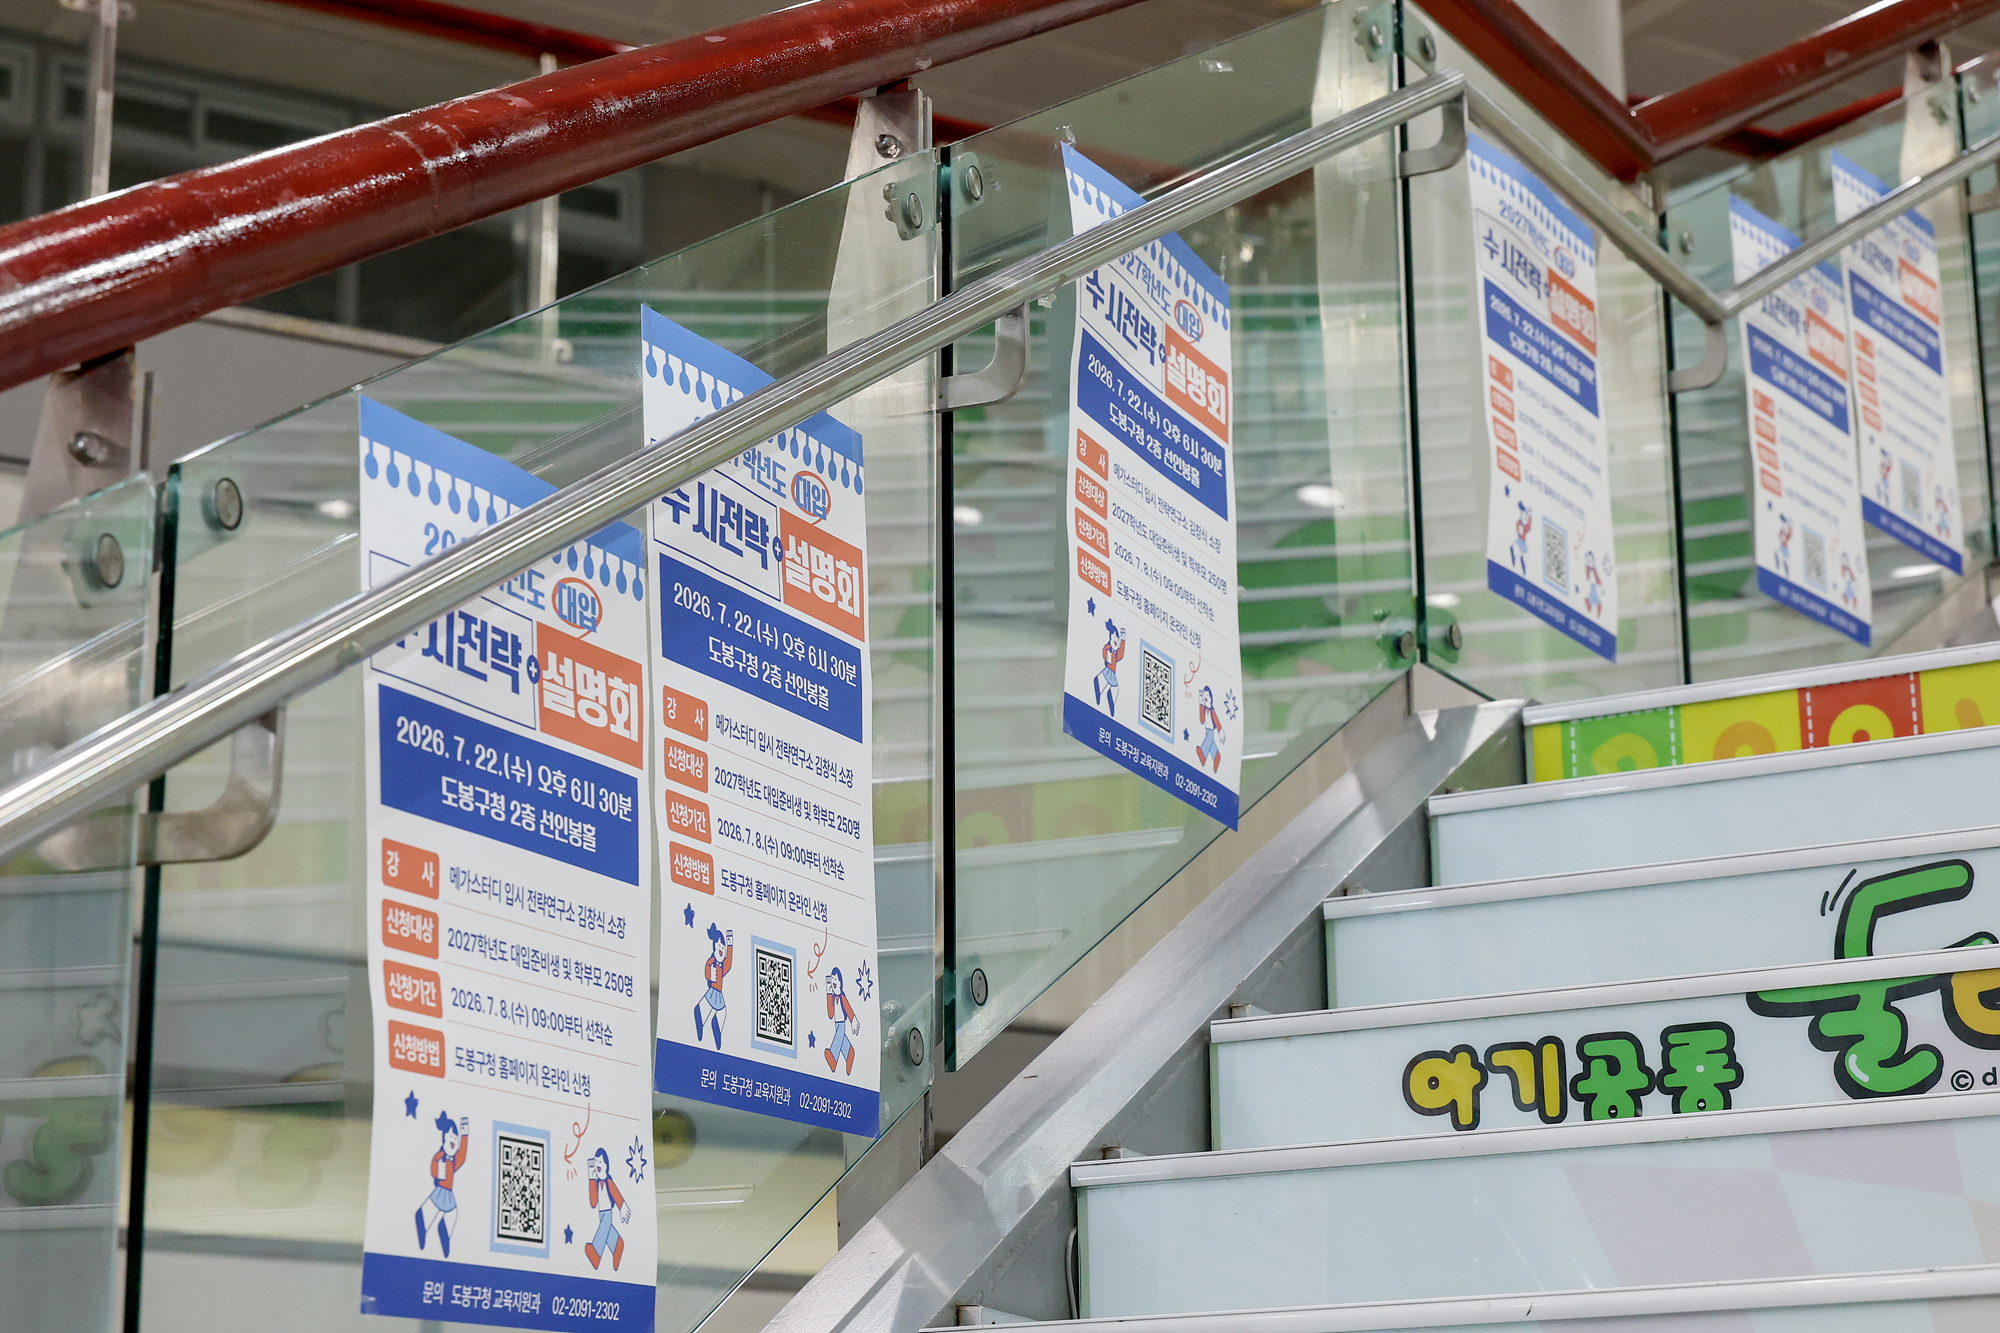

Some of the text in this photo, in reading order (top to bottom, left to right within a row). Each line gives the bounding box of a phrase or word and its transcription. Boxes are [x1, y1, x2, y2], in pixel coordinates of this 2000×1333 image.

[1484, 228, 1542, 300] 수시전략
[1086, 270, 1226, 426] 수시전략 설명회
[1178, 301, 1200, 342] 대입
[1088, 354, 1114, 392] 2026.
[1118, 378, 1126, 401] 7.
[1128, 389, 1160, 430] 22.(수)
[1163, 418, 1181, 444] 오후
[1201, 446, 1222, 478] 30분
[1110, 402, 1200, 489] 도봉구청 2층 선인봉홀
[796, 474, 826, 520] 대입
[1078, 474, 1105, 508] 신청대상
[1114, 462, 1144, 500] 메가스터디
[1209, 534, 1222, 554] 소장
[662, 481, 860, 618] 수시전략 설명회
[1078, 517, 1106, 550] 신청기간
[1112, 502, 1148, 540] 2027학년도
[1208, 570, 1228, 595] 250명
[1080, 556, 1108, 589] 신청방법
[1114, 542, 1136, 566] 2026.
[1136, 556, 1144, 572] 7.
[1144, 560, 1162, 588] 8.(수)
[1197, 596, 1215, 622] 선착순
[556, 582, 598, 634] 대입
[674, 582, 856, 688] 2026. 7. 22.(수) 오후 6시 30분
[1116, 580, 1201, 650] 도봉구청 홈페이지 온라인 신청
[396, 610, 639, 742] 시전략 설명회
[708, 636, 830, 712] 도봉구청 2층 선인봉홀
[396, 716, 632, 823] 2026. 7. 22.(수) 오후 6시 30분
[668, 746, 704, 780] 신청대상
[716, 714, 854, 789] 메가스터디 입시 전략연구소 김창식 소장
[1098, 727, 1218, 809] 문의 도봉구청 교육지원과 02-2091-2302
[442, 776, 596, 853] 도봉구청 2층 선인봉홀
[670, 801, 706, 834] 신청기간
[714, 766, 860, 840] 2027학년도 대입준비생 및 학부모 250명
[674, 852, 710, 886] 신청방법
[718, 818, 845, 881] 2026. 7. 8.(수) 09:00부터 선착순
[386, 908, 434, 944] 신청대상
[450, 866, 626, 940] 메가스터디 입시 전략연구소 김창식 소장
[721, 868, 828, 924] 도봉구청 홈페이지 온라인 신청
[388, 972, 436, 1008] 신청기간
[448, 928, 634, 998] 2027학년도 대입준비생 및 학부모 250명
[393, 1032, 440, 1068] 신청방법
[451, 987, 613, 1047] 2026. 7. 8.(수) 09:00부터 선착순
[454, 1046, 591, 1098] 도봉구청 홈페이지 온라인 신청
[700, 1068, 852, 1119] 문의 도봉구청 교육지원과 02-2091-2302
[1402, 1022, 1744, 1132] 아기공룡
[423, 1280, 620, 1321] 문의 도봉구청 교육지원과 02-2091-2302
